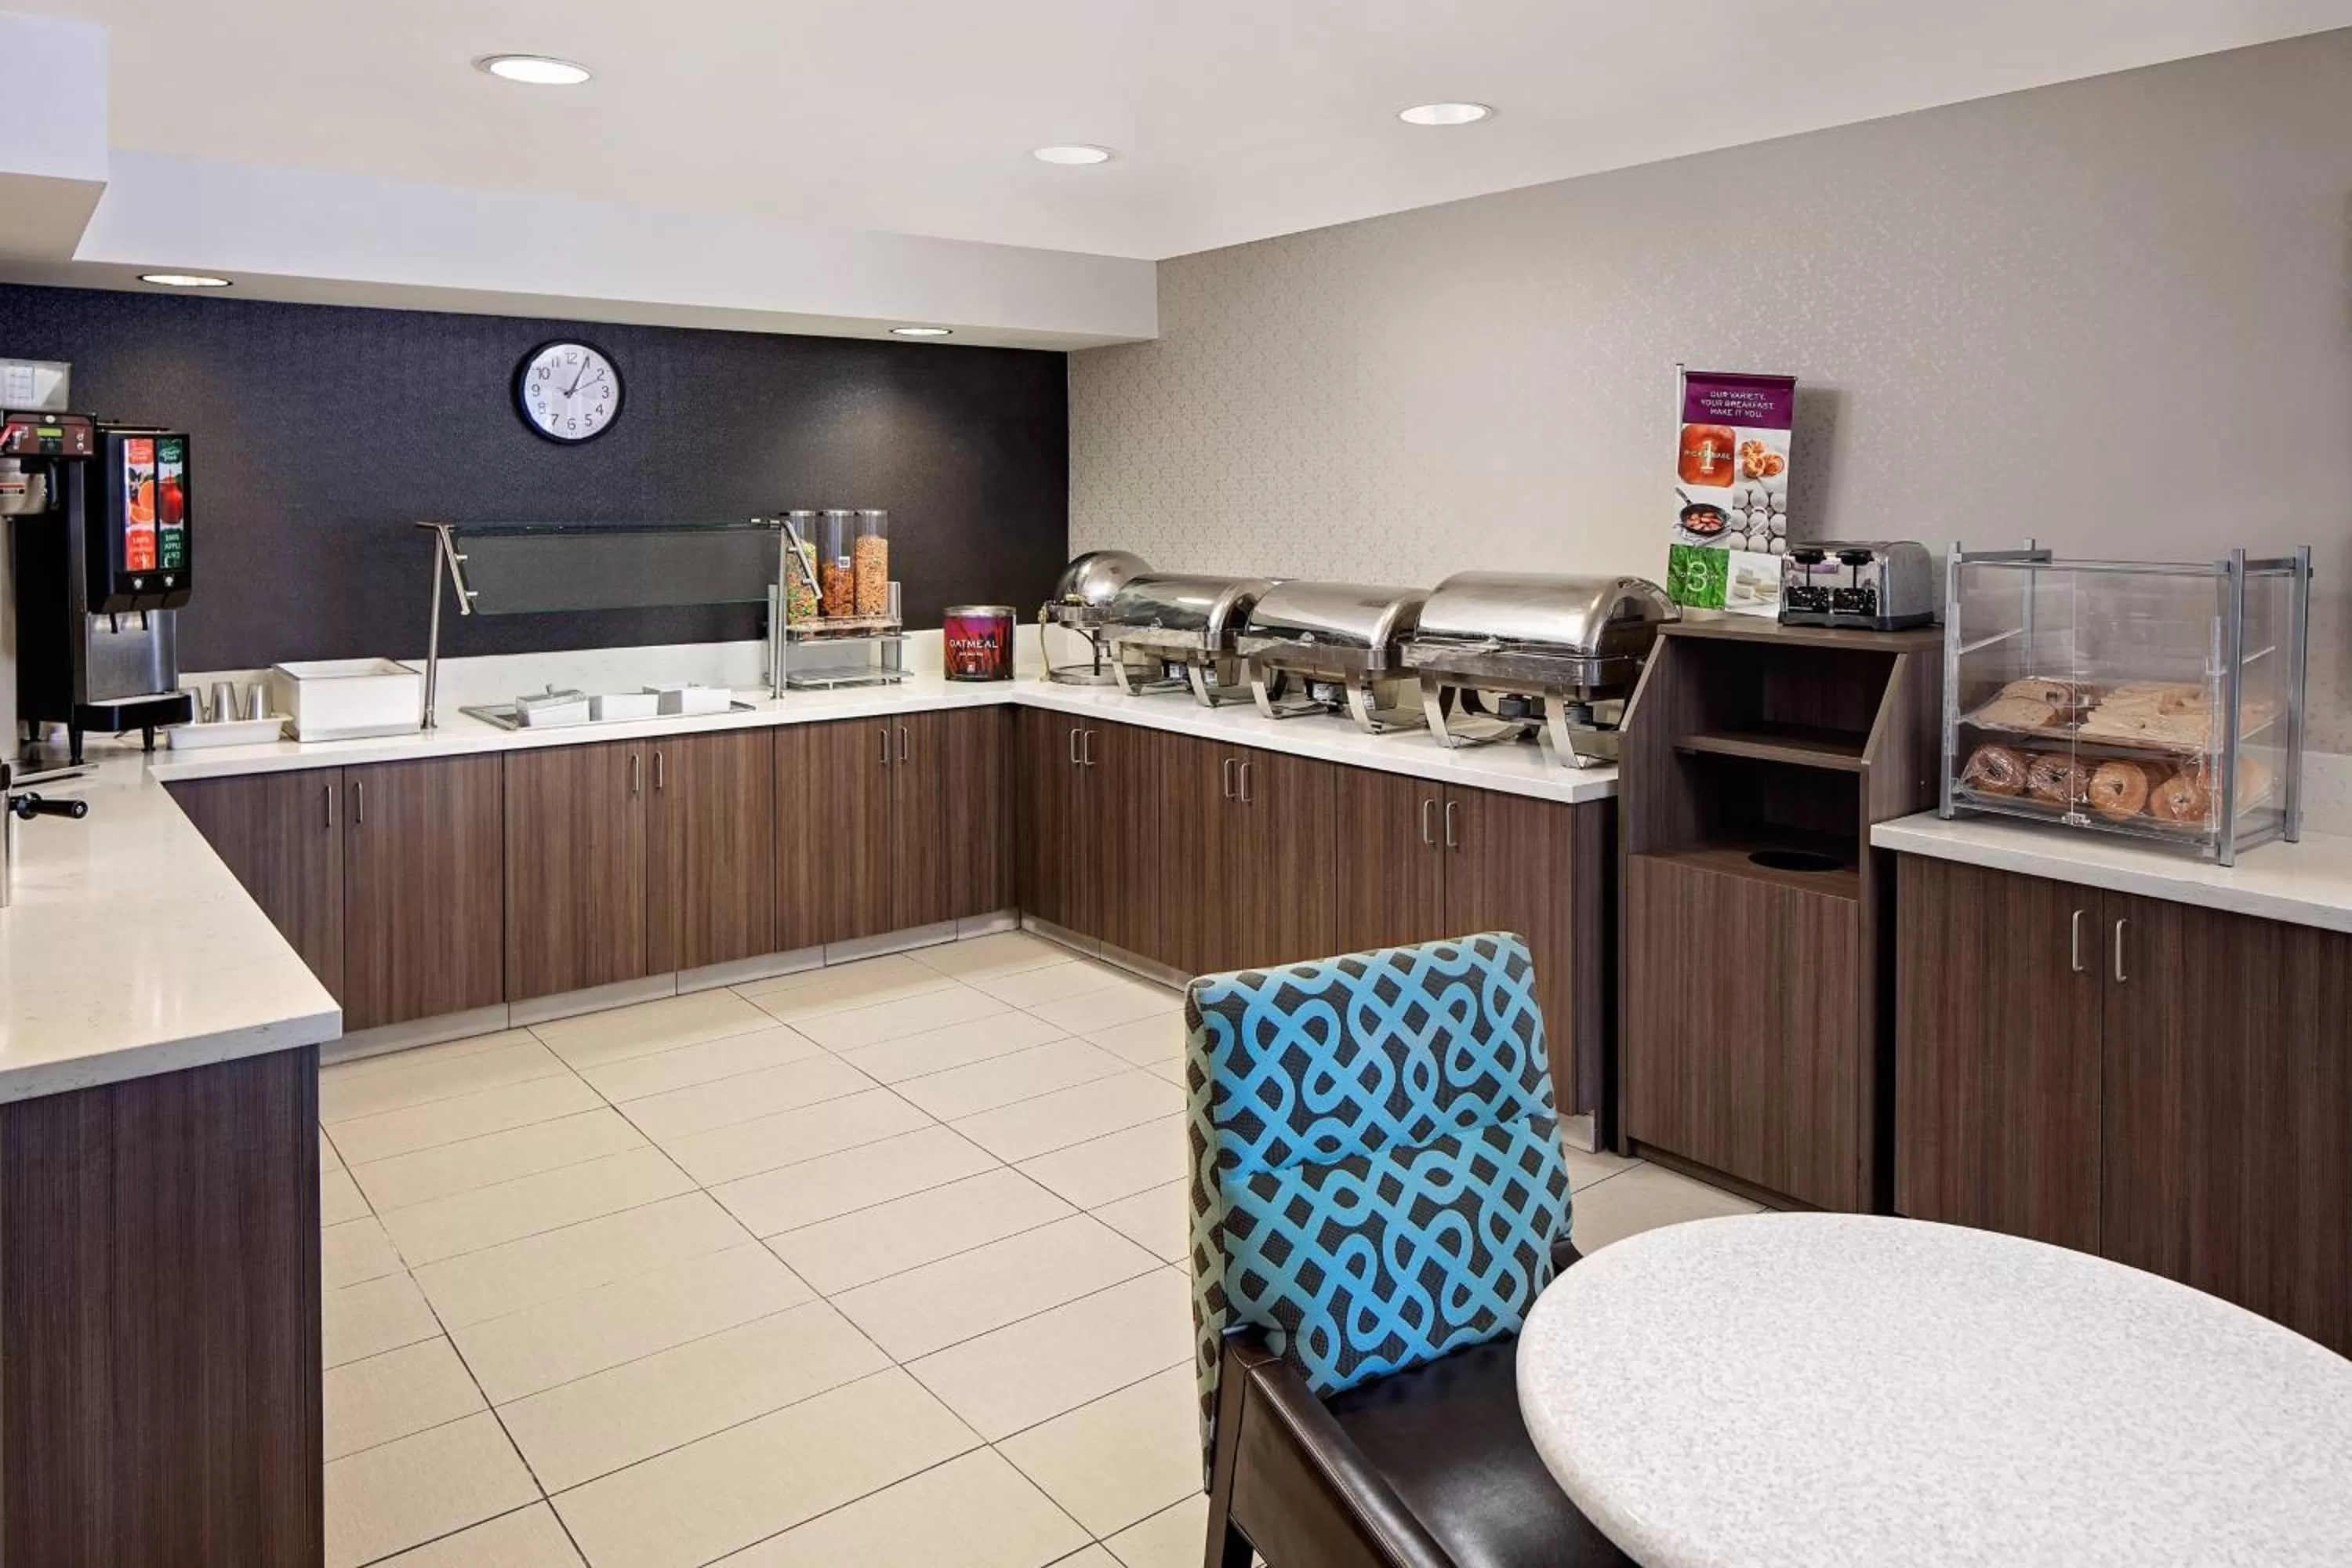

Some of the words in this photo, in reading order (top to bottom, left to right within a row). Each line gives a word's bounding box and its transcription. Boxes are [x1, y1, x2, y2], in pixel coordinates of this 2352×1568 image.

[552, 357, 559, 368] 11
[565, 352, 577, 365] 12
[536, 367, 550, 380] 10
[597, 368, 604, 381] 2
[532, 384, 540, 397] 9
[602, 386, 609, 399] 3
[538, 401, 546, 415] 8
[595, 403, 604, 416] 4
[550, 413, 559, 426] 7
[567, 418, 576, 430] 6
[584, 414, 593, 426] 5
[1700, 440, 1715, 470] 1
[1750, 506, 1769, 537] 2
[1686, 561, 1707, 592] 3
[949, 639, 998, 649] OATMEAL
